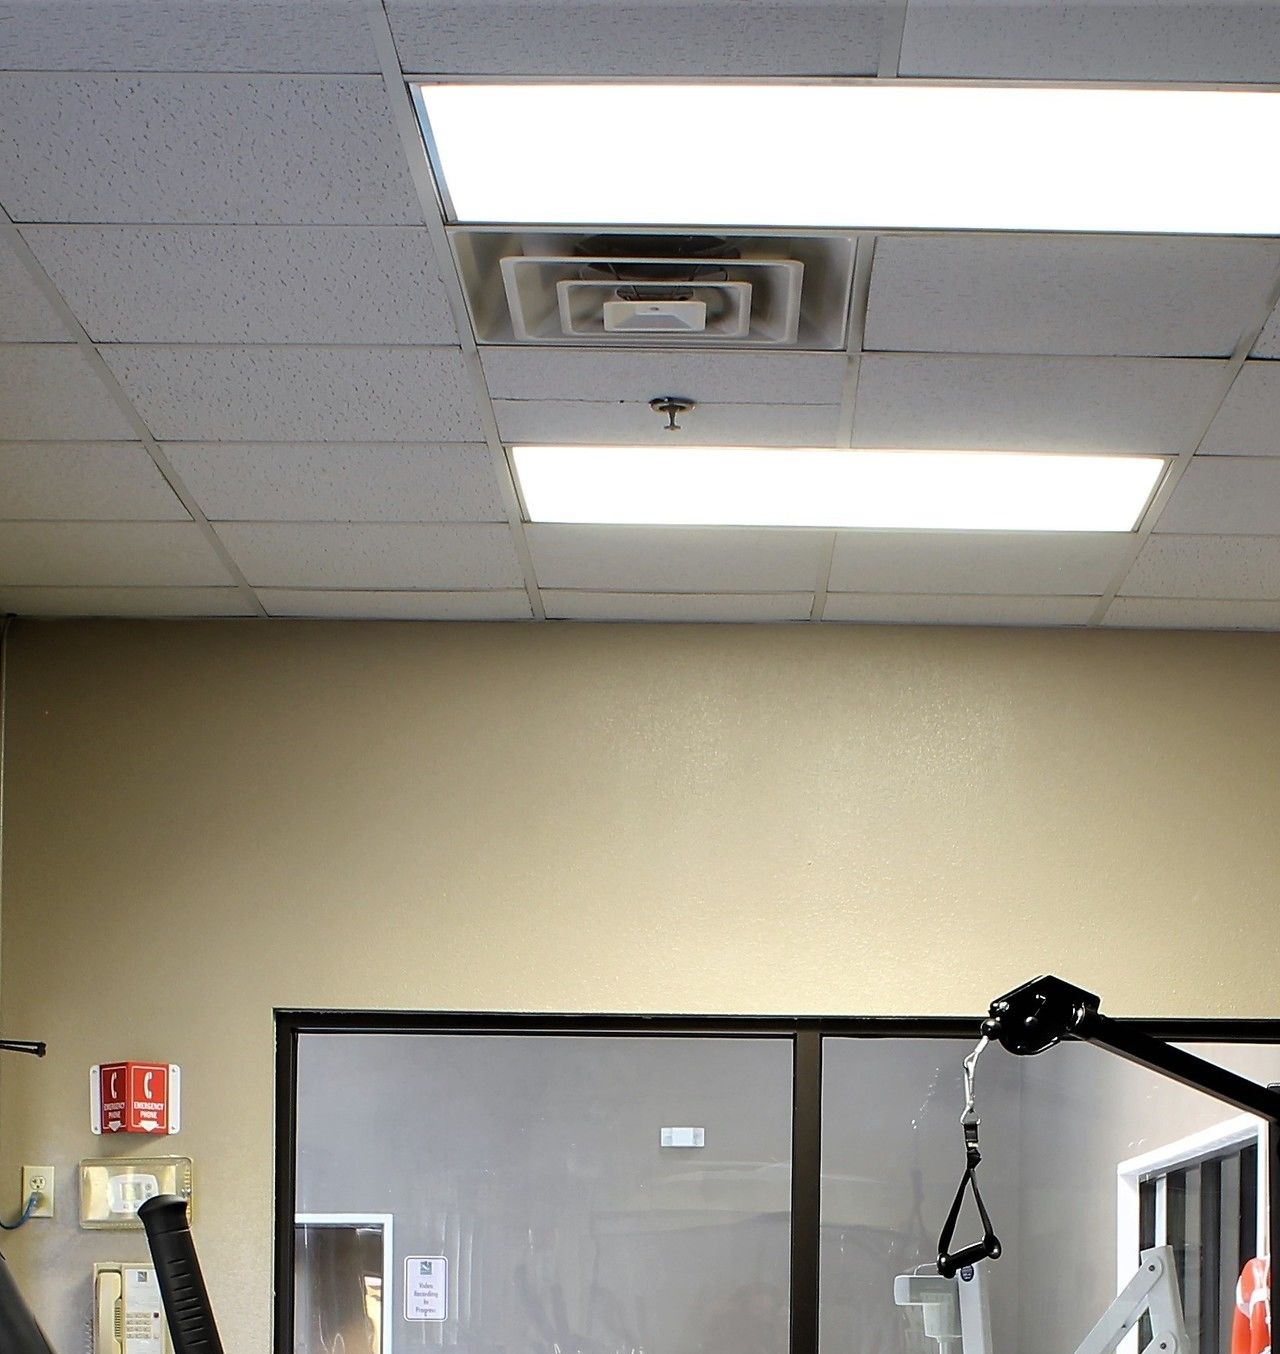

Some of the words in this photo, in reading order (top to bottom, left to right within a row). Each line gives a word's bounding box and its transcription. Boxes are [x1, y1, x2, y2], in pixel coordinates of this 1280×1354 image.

[133, 1102, 164, 1110] EMERGENCY
[140, 1111, 157, 1119] PHONE
[414, 1291, 439, 1299] Recording
